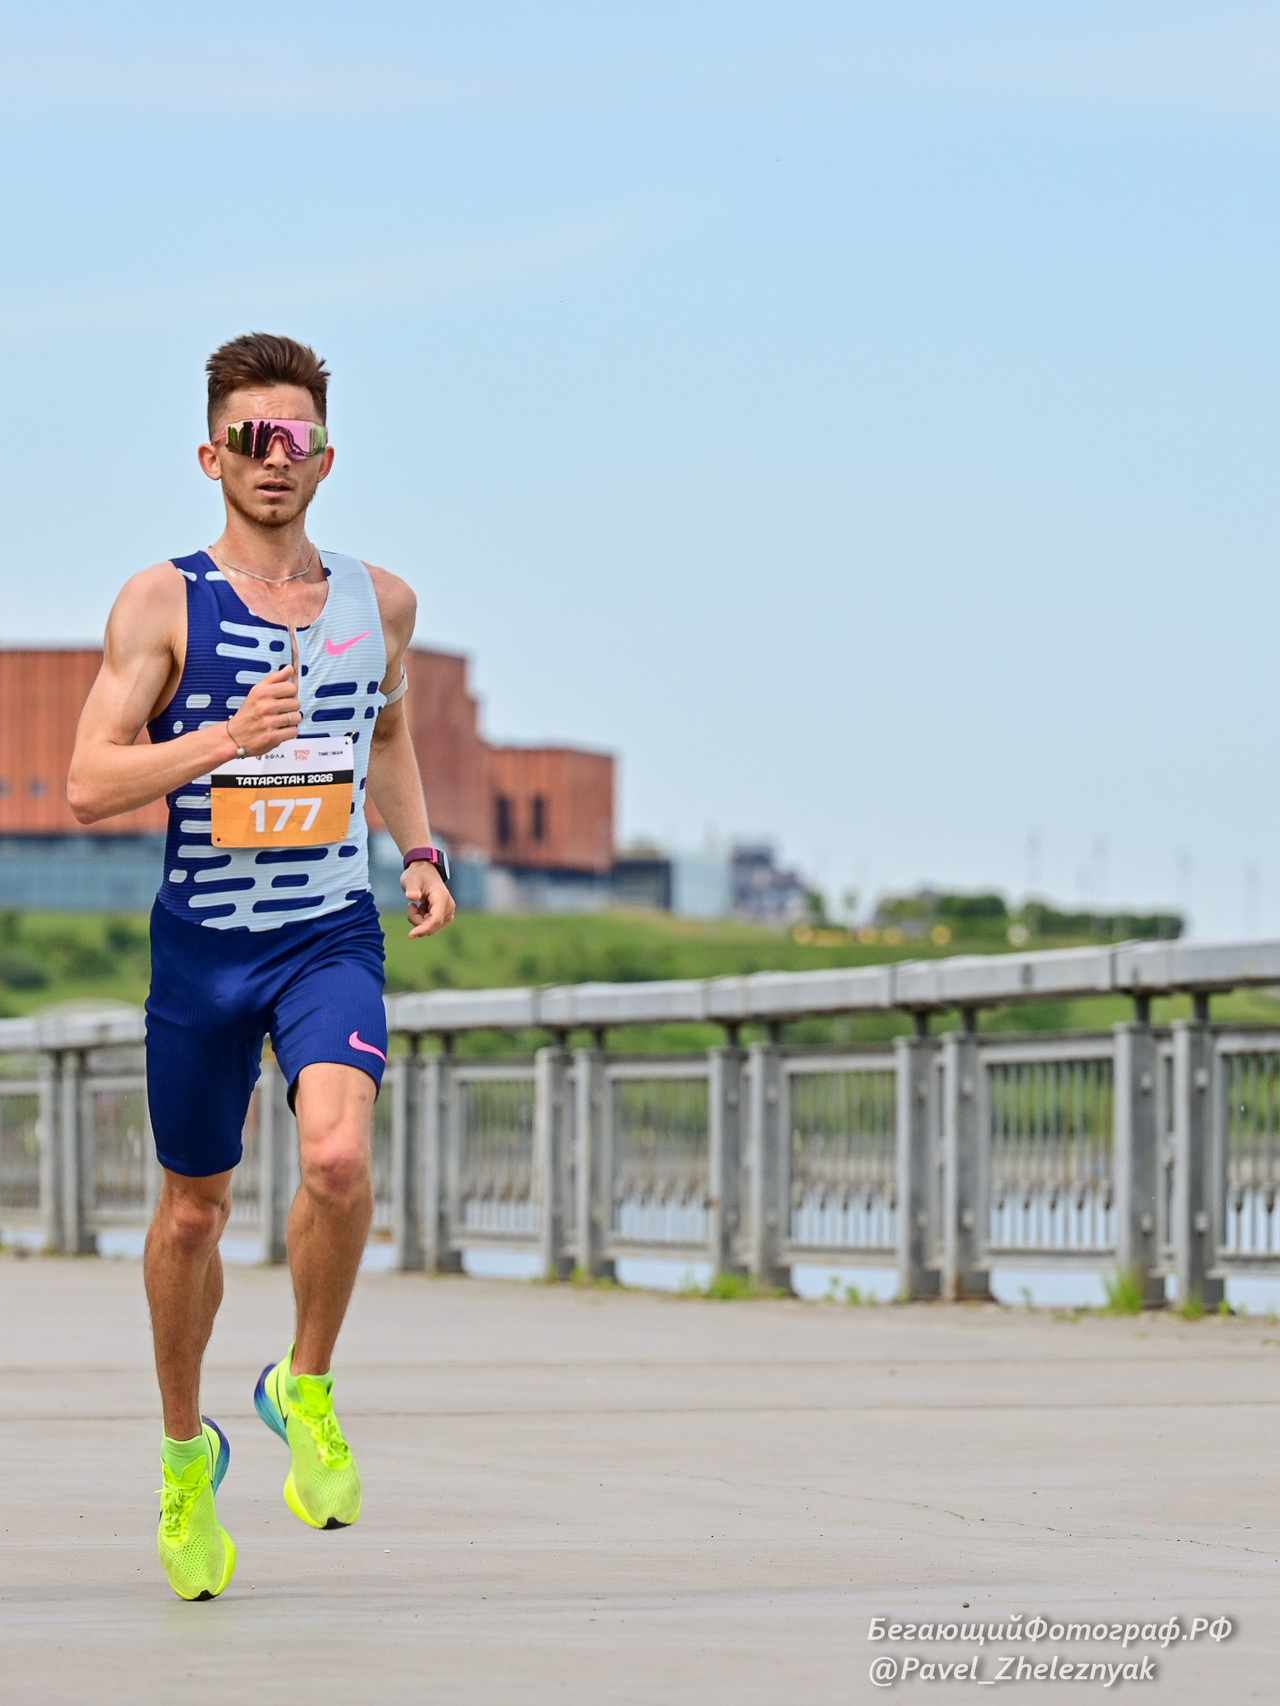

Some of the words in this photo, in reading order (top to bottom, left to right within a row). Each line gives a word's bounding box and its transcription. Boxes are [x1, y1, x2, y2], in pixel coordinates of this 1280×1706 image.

[236, 775, 305, 785] ТАТАРСТАН
[307, 773, 334, 783] 2026
[249, 797, 323, 833] 177
